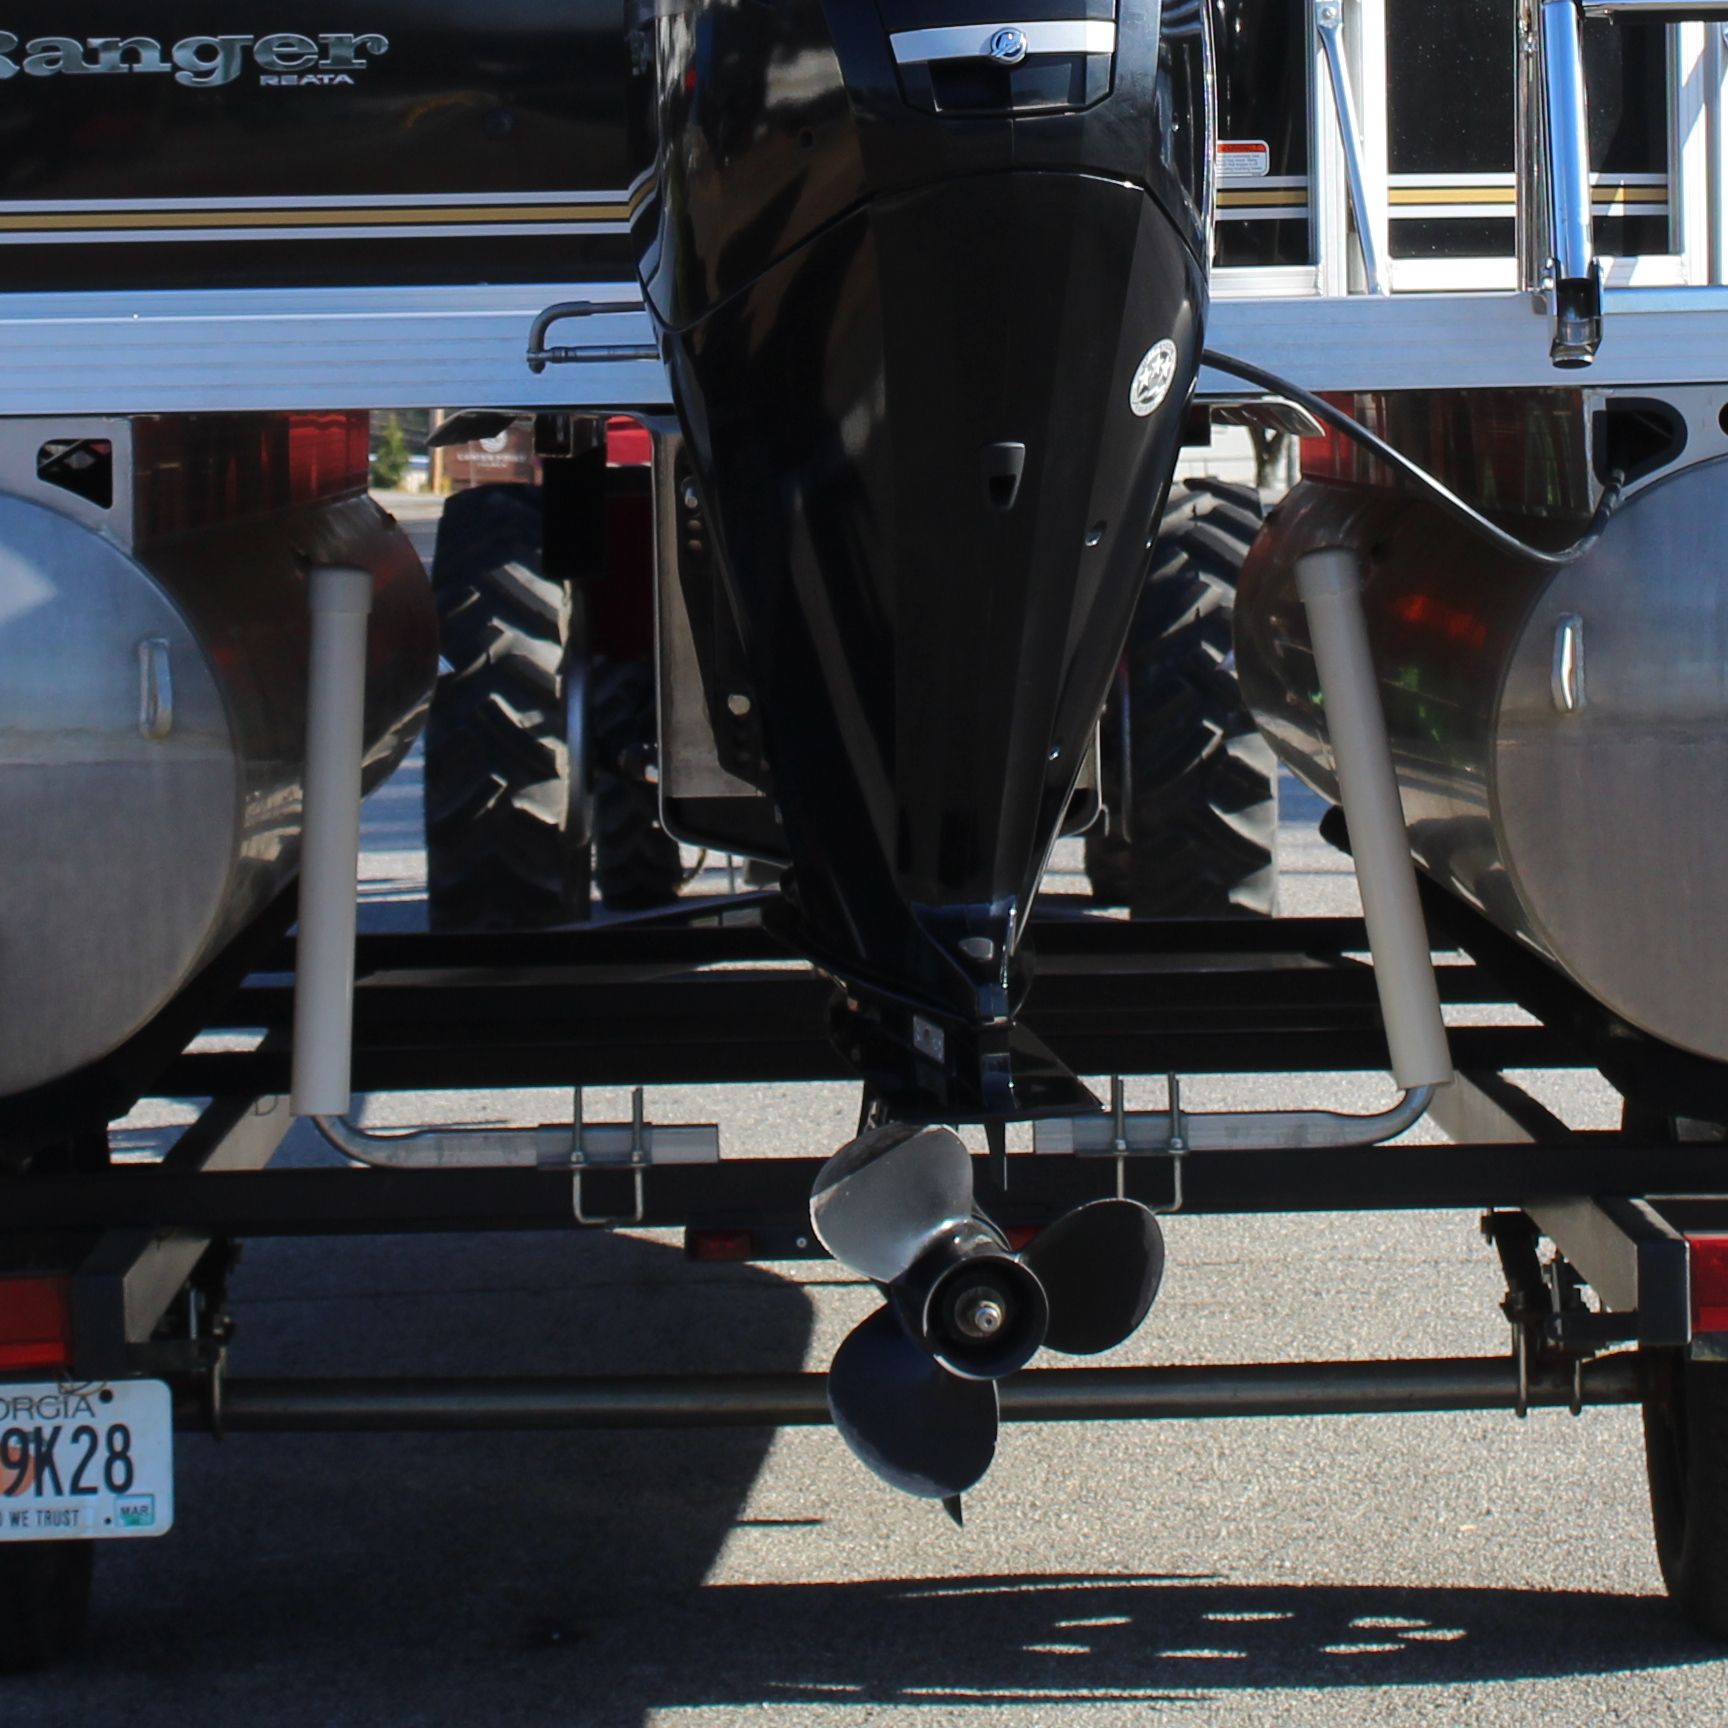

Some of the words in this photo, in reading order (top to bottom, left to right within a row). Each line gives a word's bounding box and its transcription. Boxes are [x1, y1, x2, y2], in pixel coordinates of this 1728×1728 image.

[259, 74, 355, 86] REATA
[120, 1505, 149, 1516] MAR
[9, 1510, 29, 1527] WE
[37, 1509, 80, 1526] TRUST
